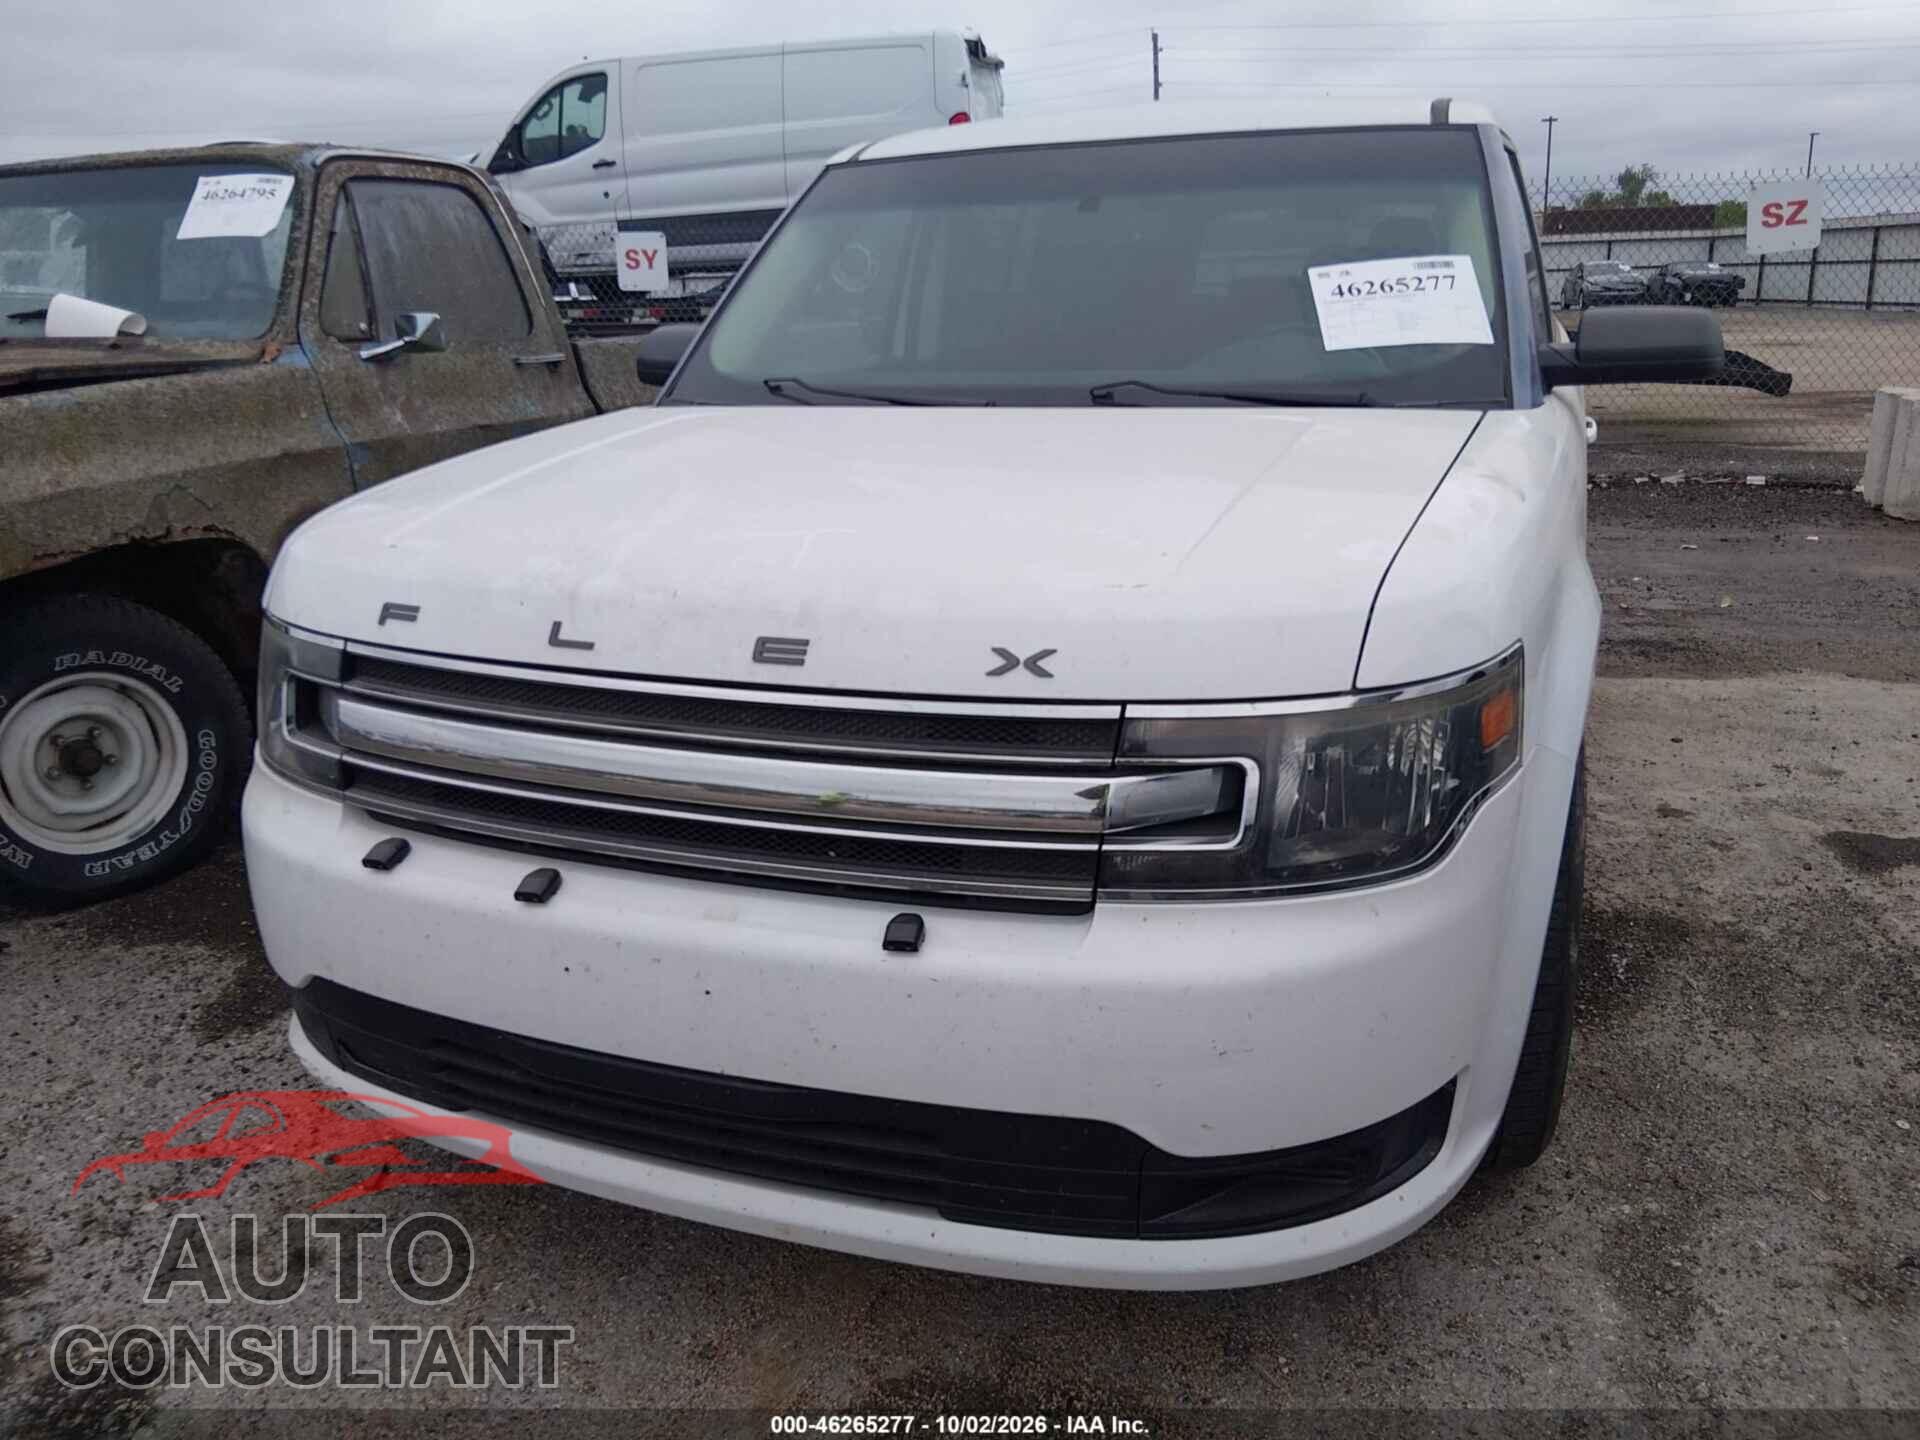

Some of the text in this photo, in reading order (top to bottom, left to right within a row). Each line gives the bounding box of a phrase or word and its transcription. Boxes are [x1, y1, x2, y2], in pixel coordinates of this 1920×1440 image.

[1761, 199, 1808, 228] SZ
[625, 248, 658, 270] SY
[1330, 274, 1456, 299] 46265277
[378, 602, 1057, 678] FLEX
[54, 650, 184, 693] RADIAL
